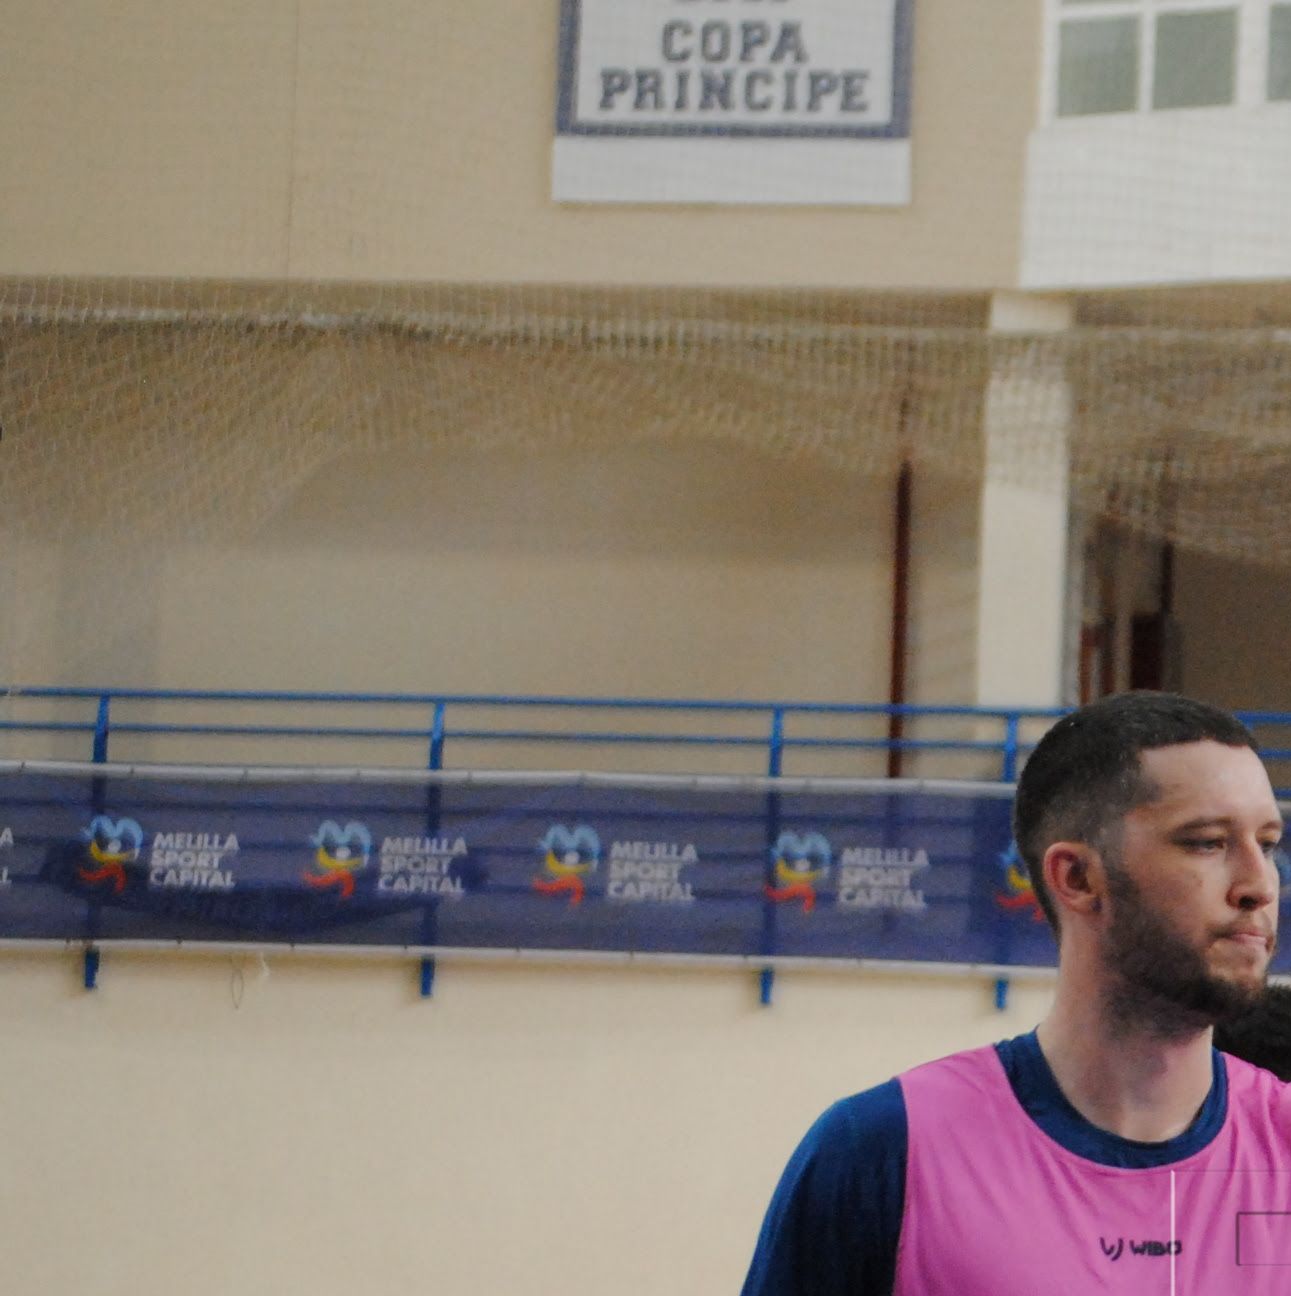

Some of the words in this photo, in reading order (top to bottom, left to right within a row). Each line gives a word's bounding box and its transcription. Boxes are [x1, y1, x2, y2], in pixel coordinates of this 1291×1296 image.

[661, 19, 809, 63] COPA
[599, 68, 870, 112] PRINCIPE
[152, 832, 240, 851] MELILLA
[381, 837, 468, 855] MELILLA
[151, 850, 223, 869] SPORT
[380, 855, 453, 874] SPORT
[150, 868, 236, 888] CAPITAL
[378, 874, 463, 894] CAPITAL
